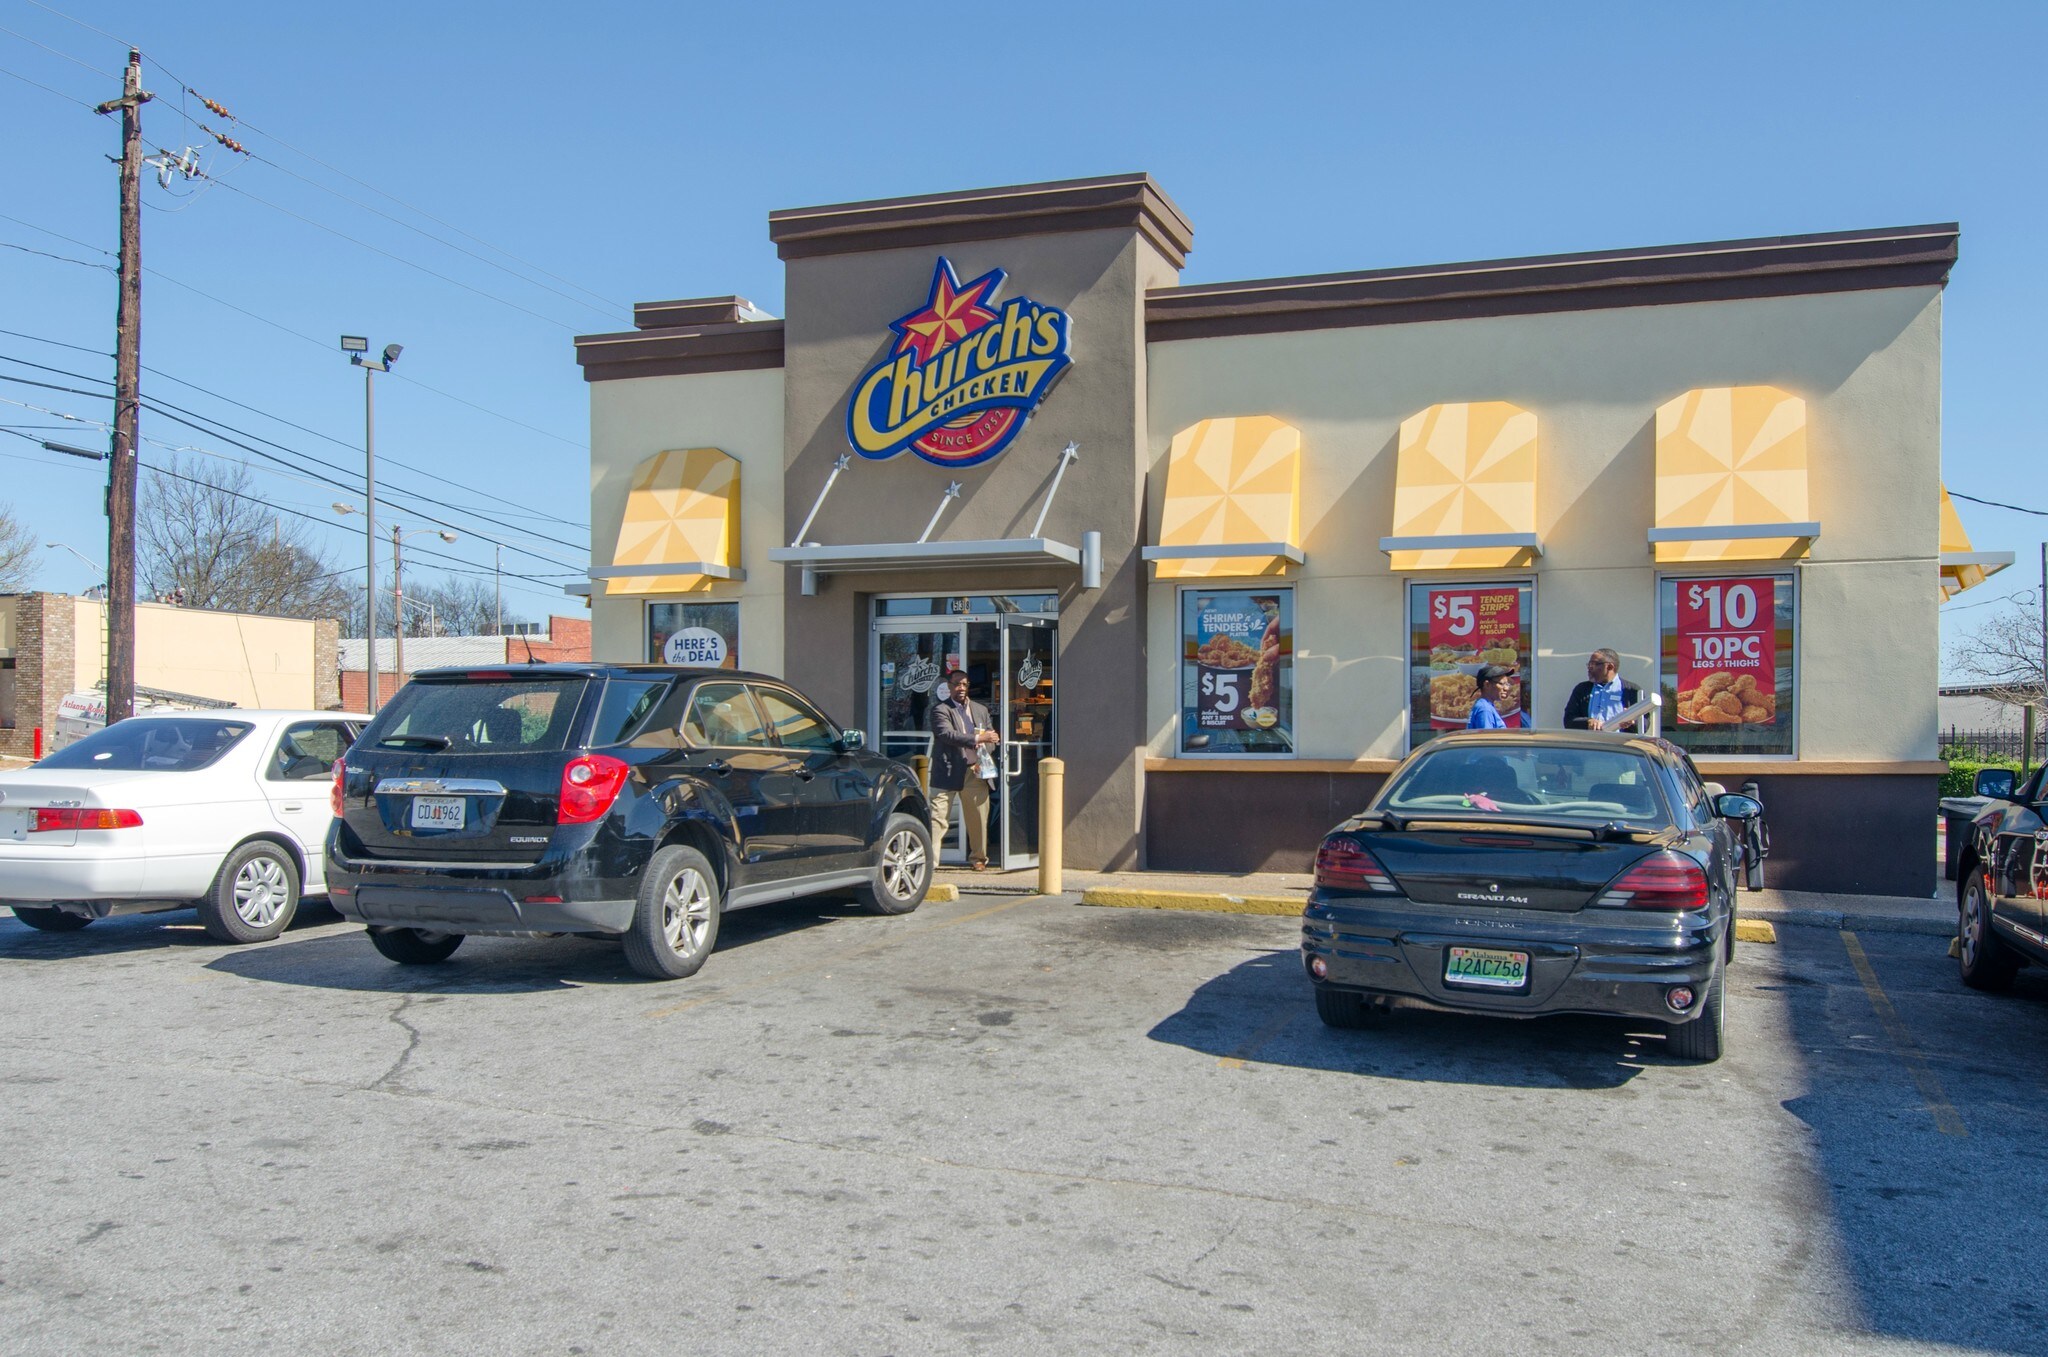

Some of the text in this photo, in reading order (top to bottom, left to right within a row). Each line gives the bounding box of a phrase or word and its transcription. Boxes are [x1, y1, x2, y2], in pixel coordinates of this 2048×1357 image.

[853, 303, 1060, 452] Church's
[930, 371, 1029, 417] CHICKEN
[931, 410, 1004, 446] SINCE 1952
[1480, 595, 1514, 603] TENDER
[953, 600, 970, 610] 538
[1480, 603, 1511, 612] STRIPS
[1688, 584, 1757, 628] $10
[1203, 613, 1244, 623] SHRIMP
[1434, 595, 1475, 636] $5
[1203, 622, 1249, 633] TENDERS
[675, 637, 718, 650] HERE'S
[1692, 636, 1760, 660] 10PC
[672, 650, 720, 663] the DEAL
[1692, 659, 1760, 669] LEGS & THIGHS
[1202, 672, 1239, 713] $5
[62, 701, 86, 711] Atlanta
[1458, 893, 1504, 901] GRAND
[1456, 919, 1523, 929] PONTIAC
[1470, 950, 1508, 960] Alabama
